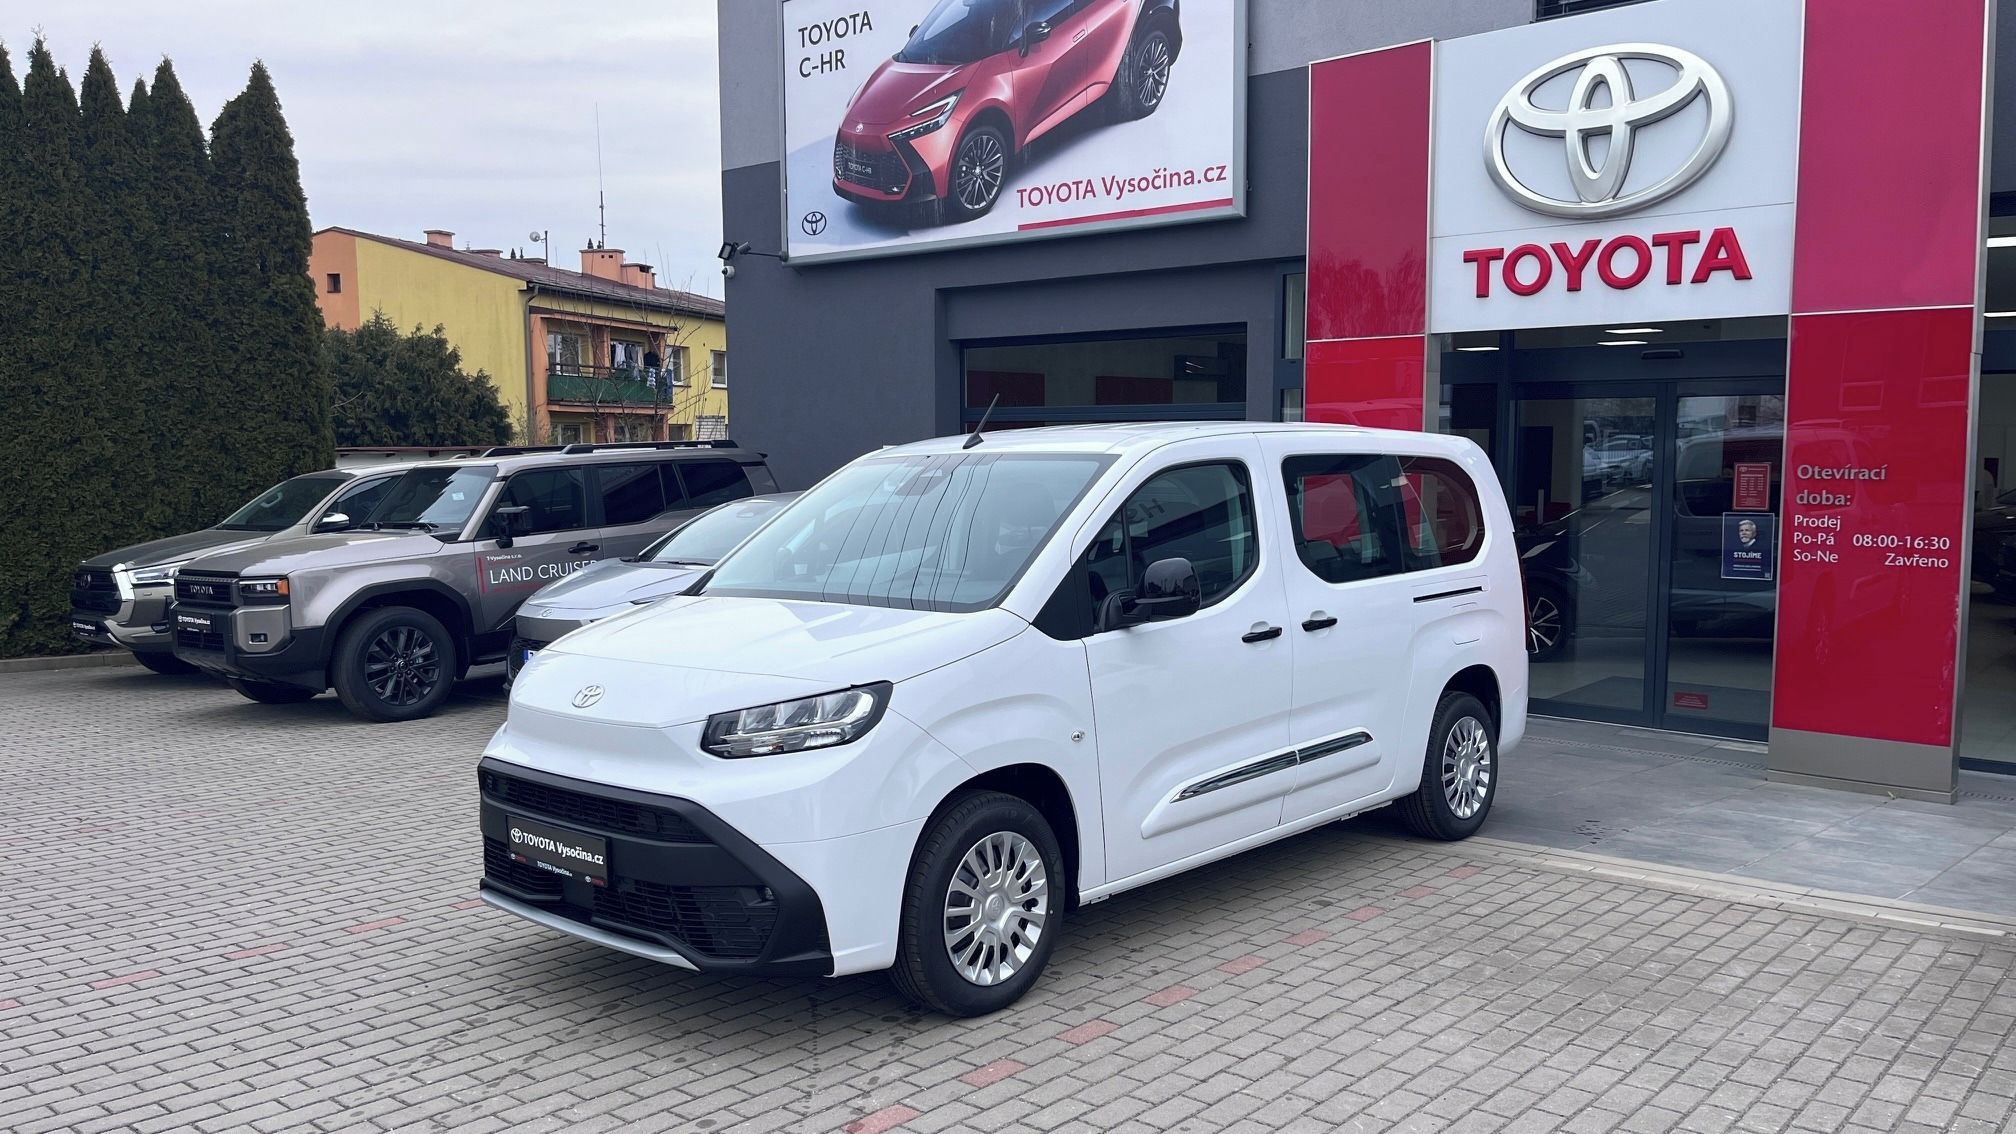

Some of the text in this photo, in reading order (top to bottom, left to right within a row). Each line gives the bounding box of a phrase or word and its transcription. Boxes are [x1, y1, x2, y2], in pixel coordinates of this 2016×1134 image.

[798, 11, 873, 49] TOYOTA
[799, 49, 846, 79] C-HR
[1016, 164, 1227, 208] TOYOTA Vysočina.cz
[1463, 227, 1752, 298] TOYOTA
[1797, 464, 1888, 480] Otevírací
[1796, 489, 1851, 505] doba:
[1794, 514, 1841, 531] Prodej
[1793, 532, 1950, 550] Po-Pá 08:00-16:30
[1793, 549, 1949, 568] So-Ne Zavřeno
[489, 566, 534, 584] LAND
[190, 584, 214, 595] TOYOTA
[522, 832, 604, 865] TOYOTA Vysočina.cz
